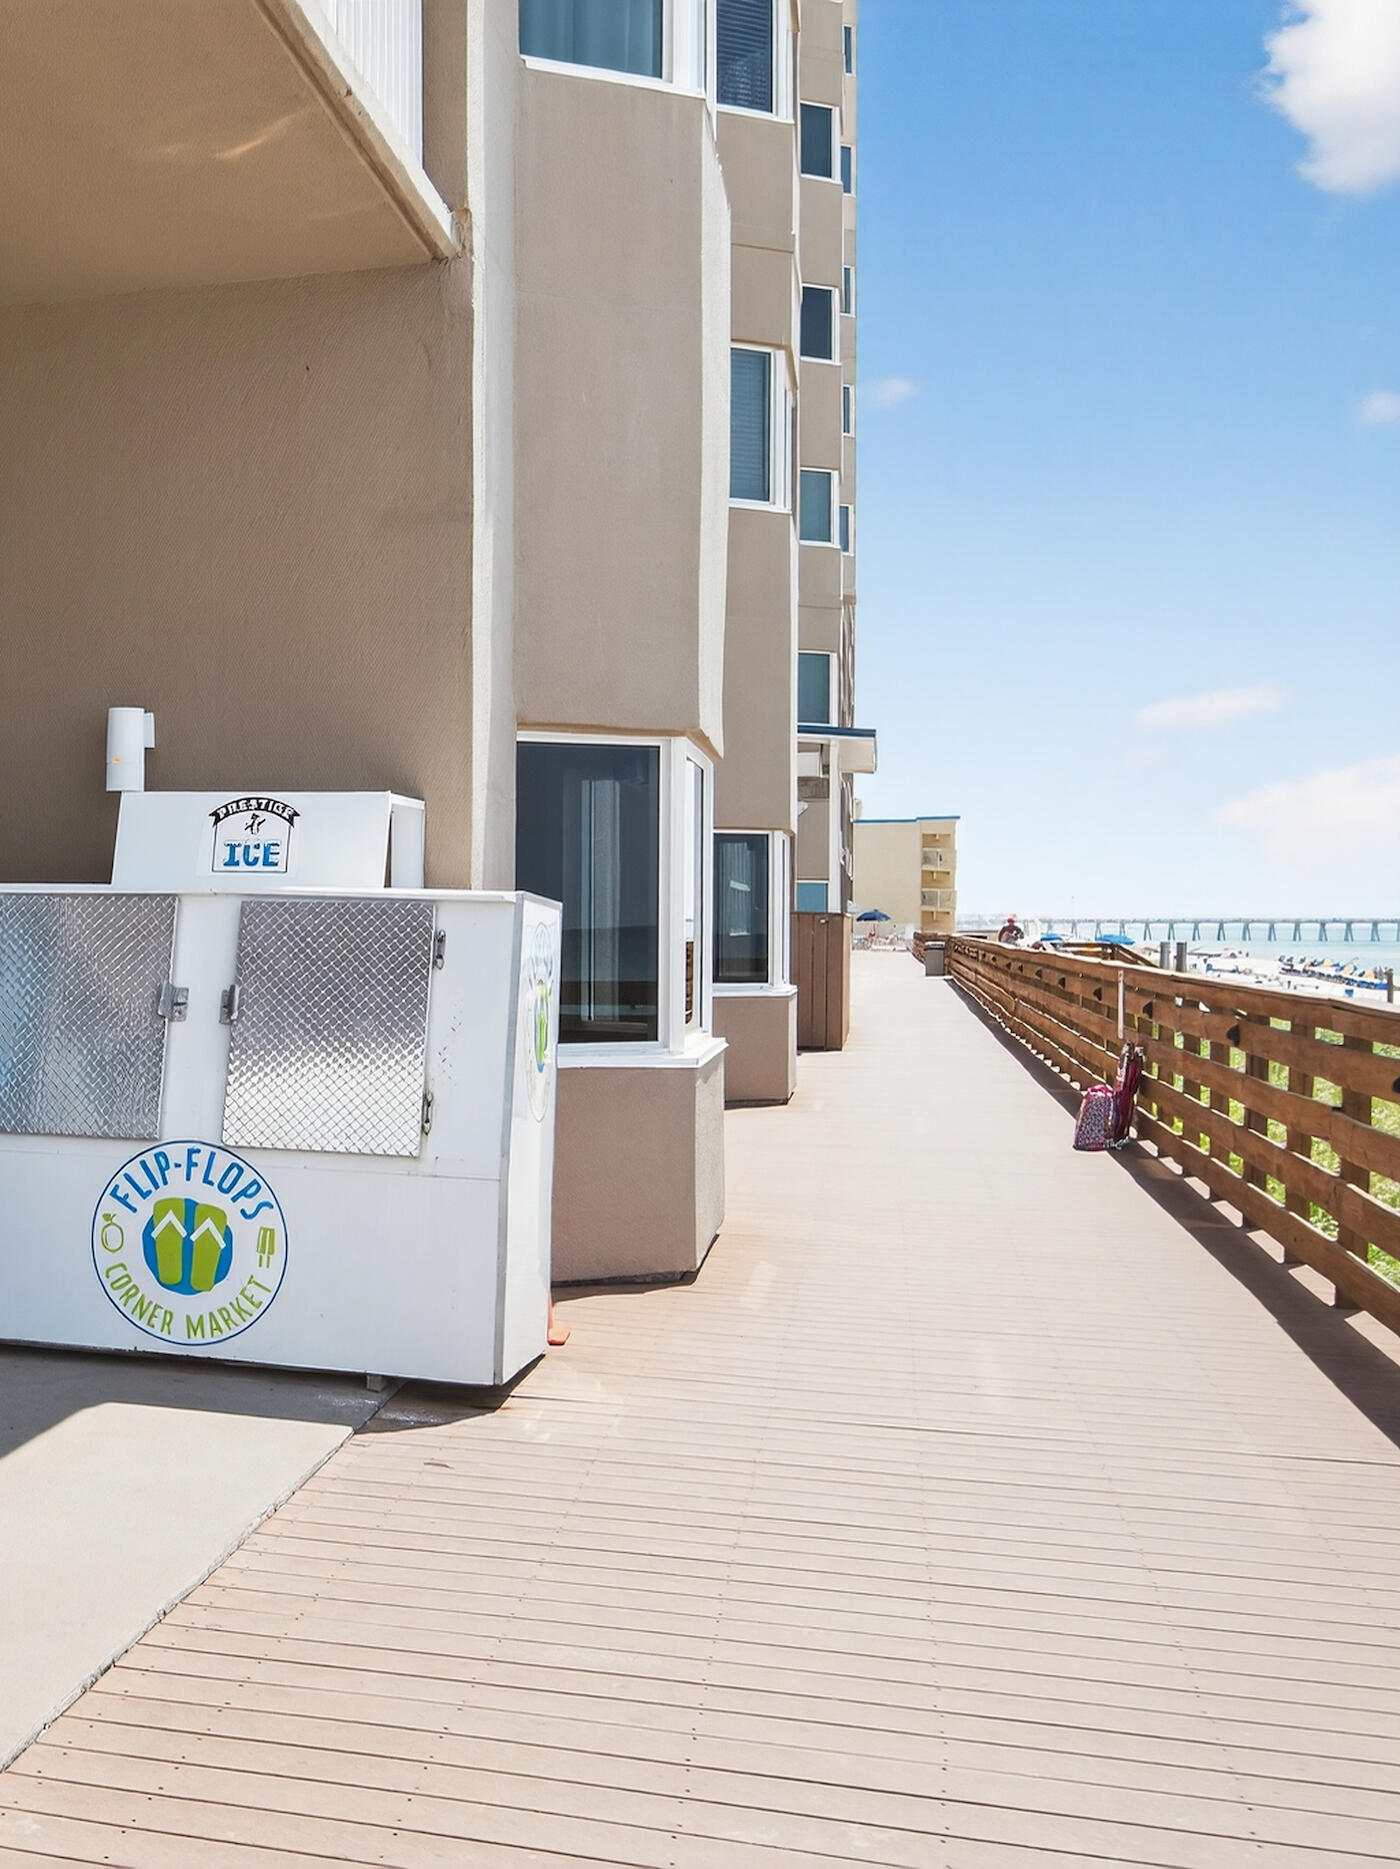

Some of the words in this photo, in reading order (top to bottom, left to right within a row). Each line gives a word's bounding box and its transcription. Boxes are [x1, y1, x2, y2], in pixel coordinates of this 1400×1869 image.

[223, 841, 280, 867] ICE
[109, 1147, 274, 1221] FLIP-FLOPS
[104, 1261, 174, 1338] CORNER
[185, 1275, 273, 1340] MARKET
